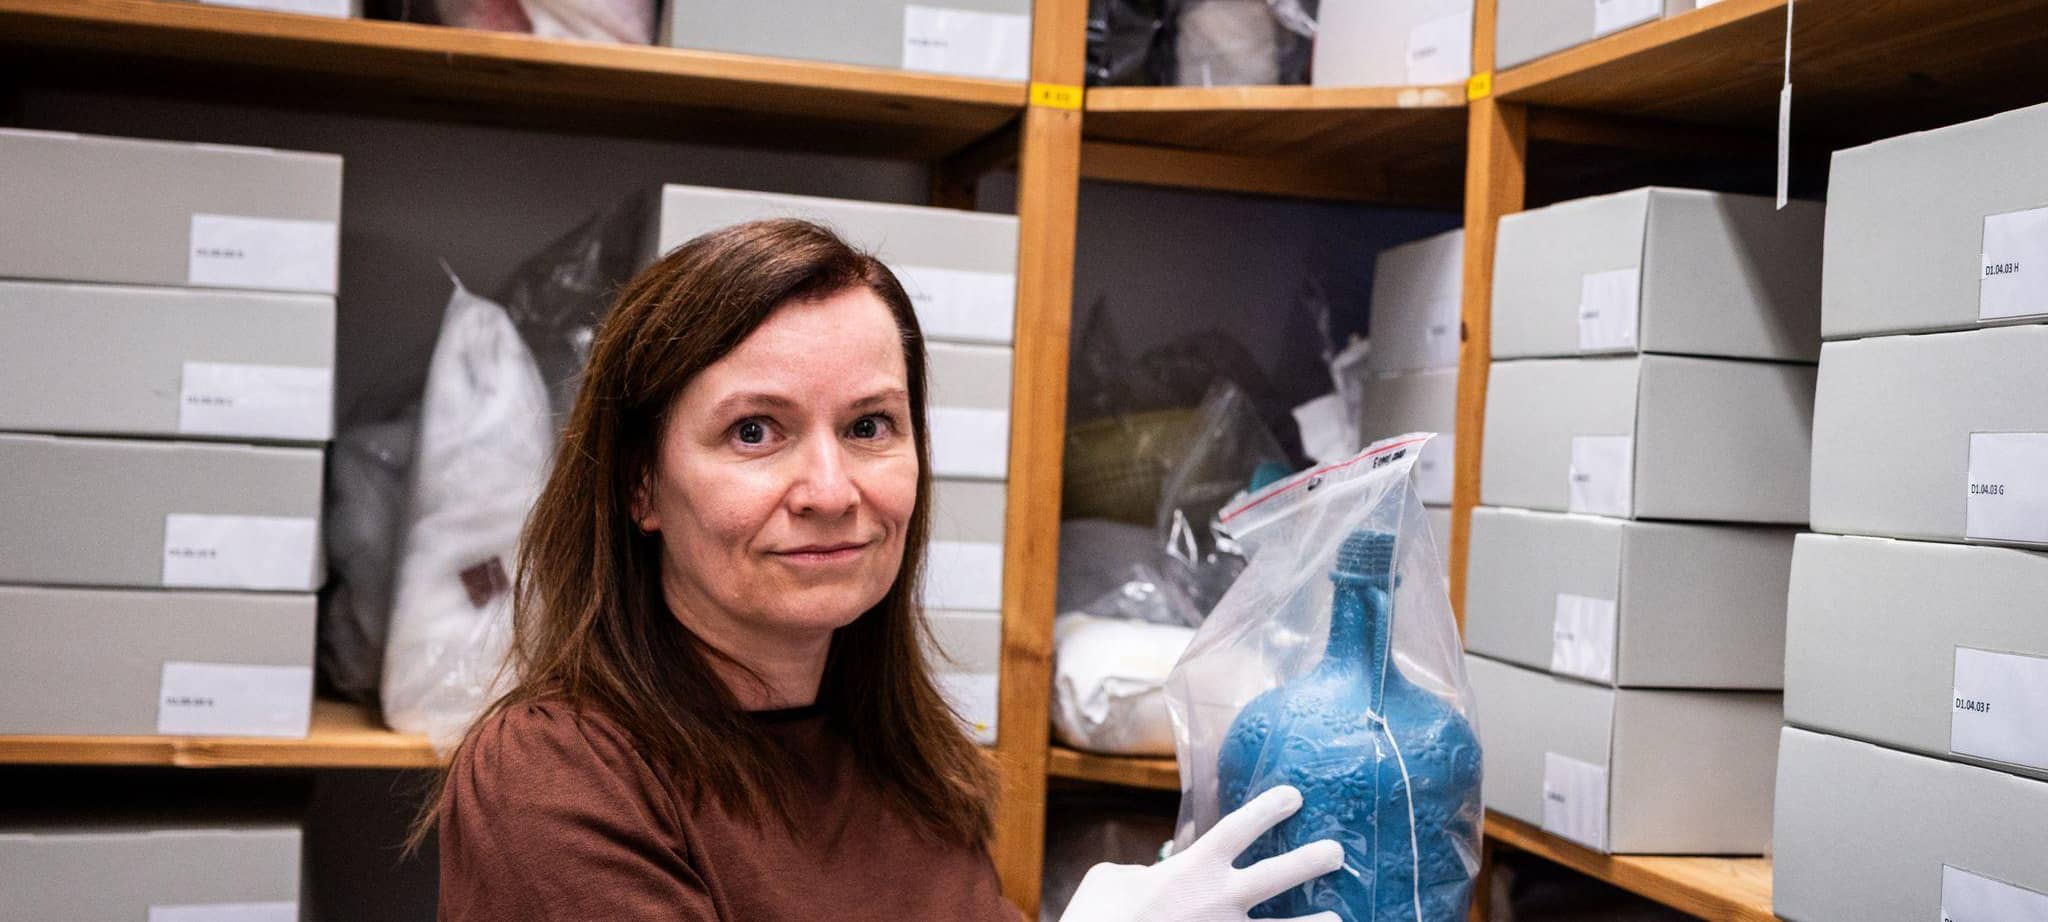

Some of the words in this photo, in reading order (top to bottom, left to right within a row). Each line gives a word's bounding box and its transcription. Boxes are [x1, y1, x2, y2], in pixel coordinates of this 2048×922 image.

[1985, 263, 2013, 275] D1.04.03
[2014, 262, 2019, 273] H
[1971, 484, 1998, 495] D1.04.03
[1999, 484, 2004, 496] G
[1956, 698, 1985, 713] D1.04.03
[1986, 703, 1991, 713] F
